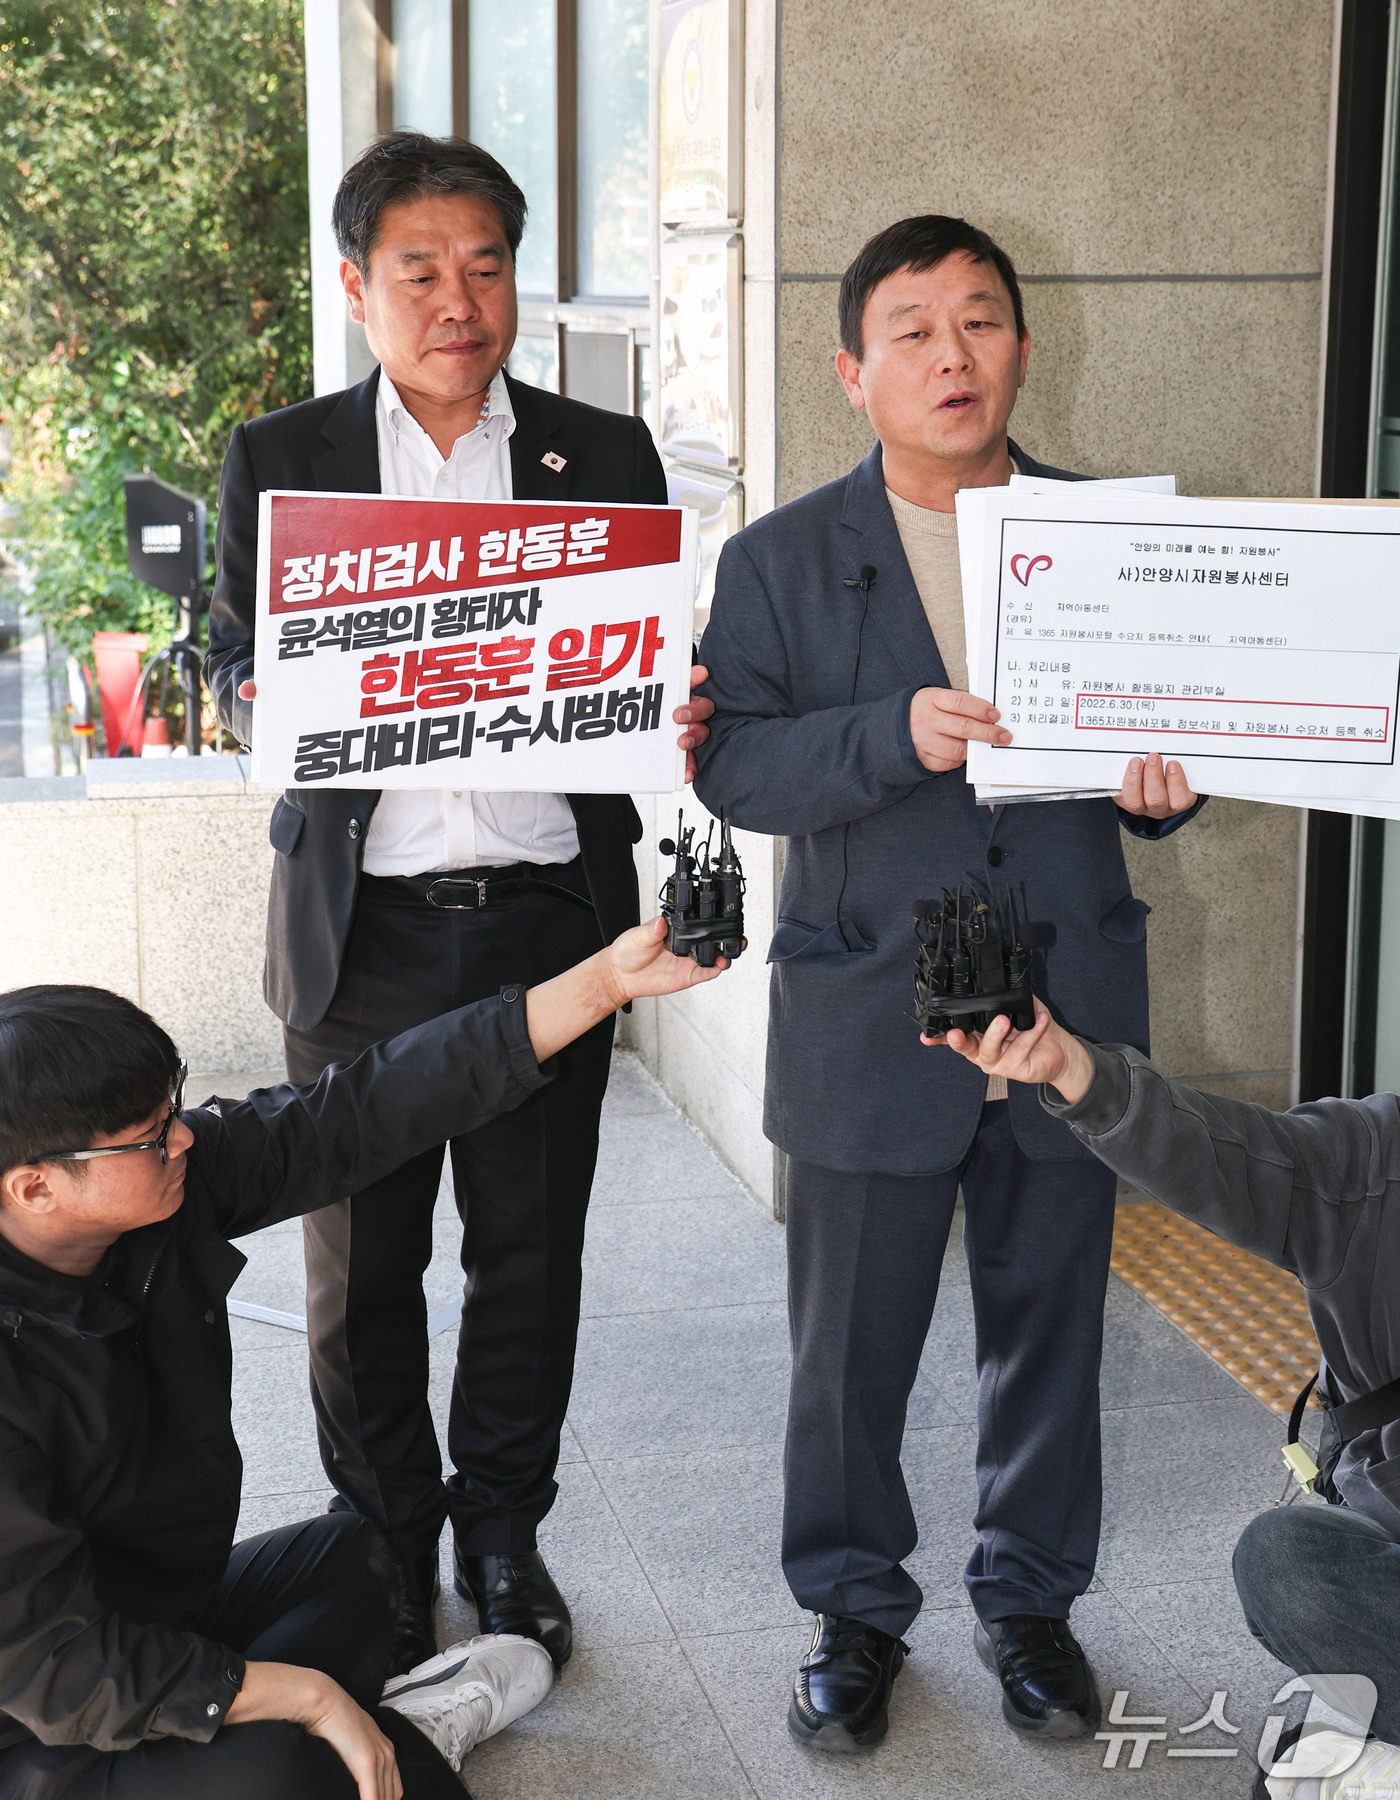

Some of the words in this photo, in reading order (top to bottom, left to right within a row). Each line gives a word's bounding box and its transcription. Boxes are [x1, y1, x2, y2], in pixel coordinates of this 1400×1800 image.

[1165, 543, 1193, 554] 미래를
[1198, 545, 1216, 555] 여는
[1221, 546, 1234, 555] 힘!
[281, 535, 465, 603] 정치검사
[477, 517, 611, 578] 한동훈
[1117, 566, 1290, 587] 사)안양시자원봉사센터
[1056, 602, 1110, 613] 지역아동센터
[278, 602, 426, 661] 윤석열의
[431, 586, 543, 639] 황태자
[1006, 614, 1033, 624] (경유)
[1038, 629, 1056, 637] 1365
[1060, 629, 1113, 640] 자원봉사포털
[1117, 632, 1143, 641] 수요처
[1148, 633, 1184, 643] 등록취소
[1188, 634, 1211, 643] 안내(
[1229, 635, 1288, 646] 지역아동센터)
[359, 635, 536, 719] 한동훈
[546, 615, 666, 692] 일가
[1007, 661, 1021, 671] 나.
[1027, 661, 1071, 673] 처리내용
[1013, 678, 1022, 689] 1)
[1028, 678, 1038, 688] 사
[1061, 679, 1076, 690] 유:
[1081, 680, 1125, 692] 자원봉사
[1131, 683, 1175, 695] 활동일지
[1181, 684, 1226, 696] 관리부실
[1011, 695, 1022, 706] 2)
[1079, 698, 1156, 711] 2022.6.30.(목)
[1010, 713, 1021, 723] 3)
[1027, 713, 1074, 725] 처리결과:
[1079, 715, 1171, 729] 1365자원봉사포털
[1177, 719, 1221, 731] 정보삭제
[1228, 721, 1237, 732] 및
[1245, 722, 1289, 734] 자원봉사
[1296, 725, 1329, 736] 수요처
[1335, 727, 1357, 737] 등록
[1363, 727, 1385, 738] 취소
